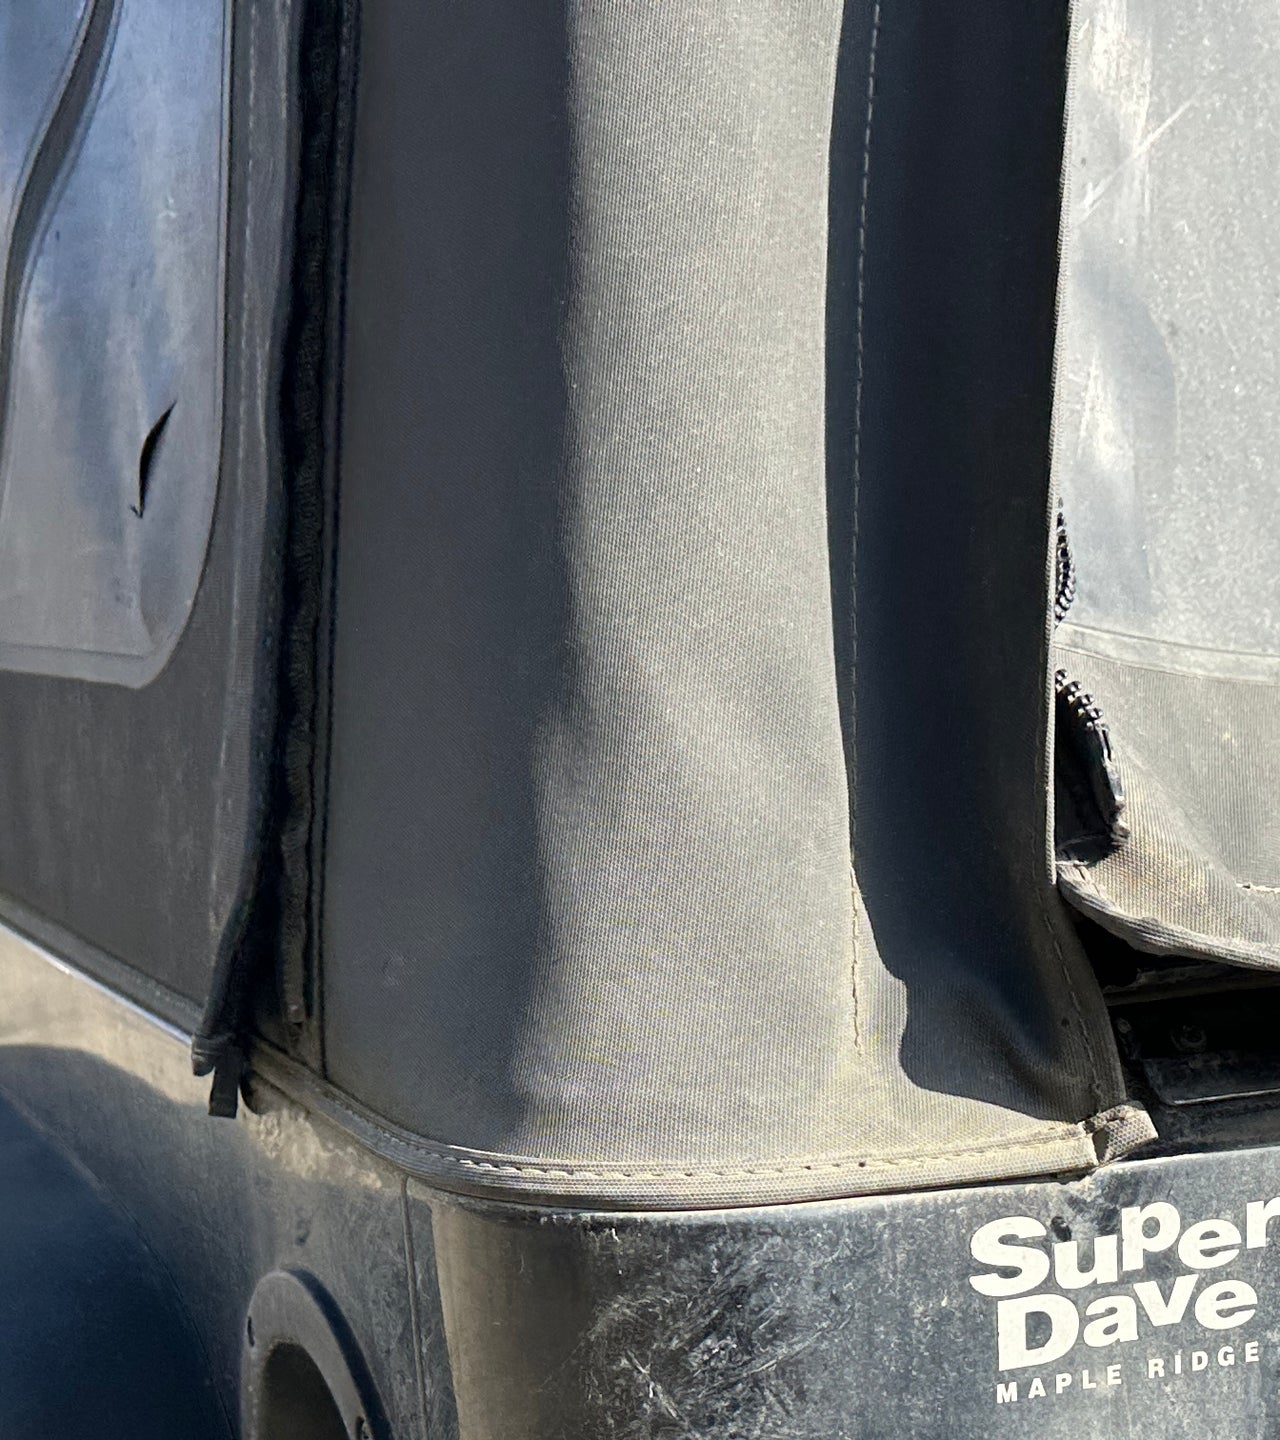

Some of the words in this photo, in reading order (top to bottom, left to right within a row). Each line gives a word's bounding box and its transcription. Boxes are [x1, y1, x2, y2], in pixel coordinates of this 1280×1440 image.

[997, 1273, 1259, 1372] Dave
[996, 1363, 1122, 1404] MAPLE
[1147, 1341, 1260, 1379] RIDGE
